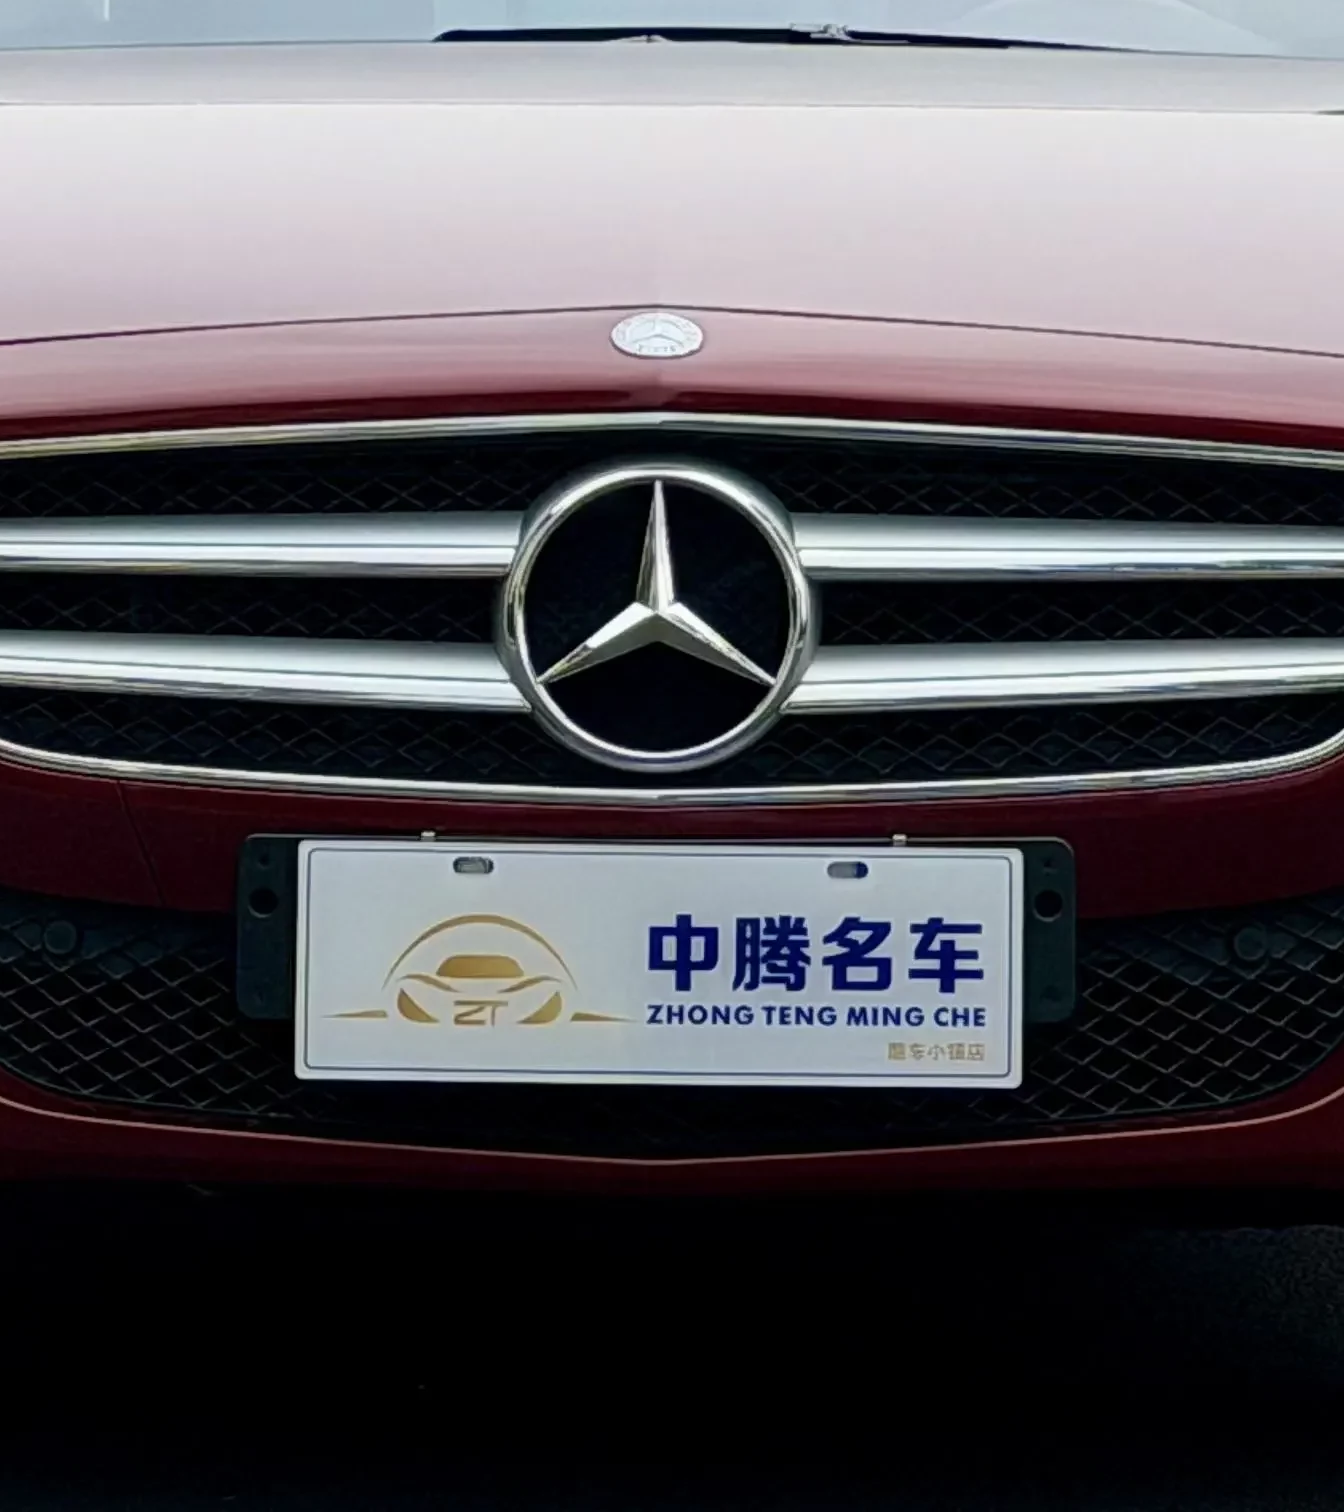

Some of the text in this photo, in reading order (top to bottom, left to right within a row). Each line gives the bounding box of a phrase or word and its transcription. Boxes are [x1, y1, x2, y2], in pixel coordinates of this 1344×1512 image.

[646, 914, 985, 994] 中腾名车
[646, 1004, 987, 1028] ZHONG TENG MING CHE
